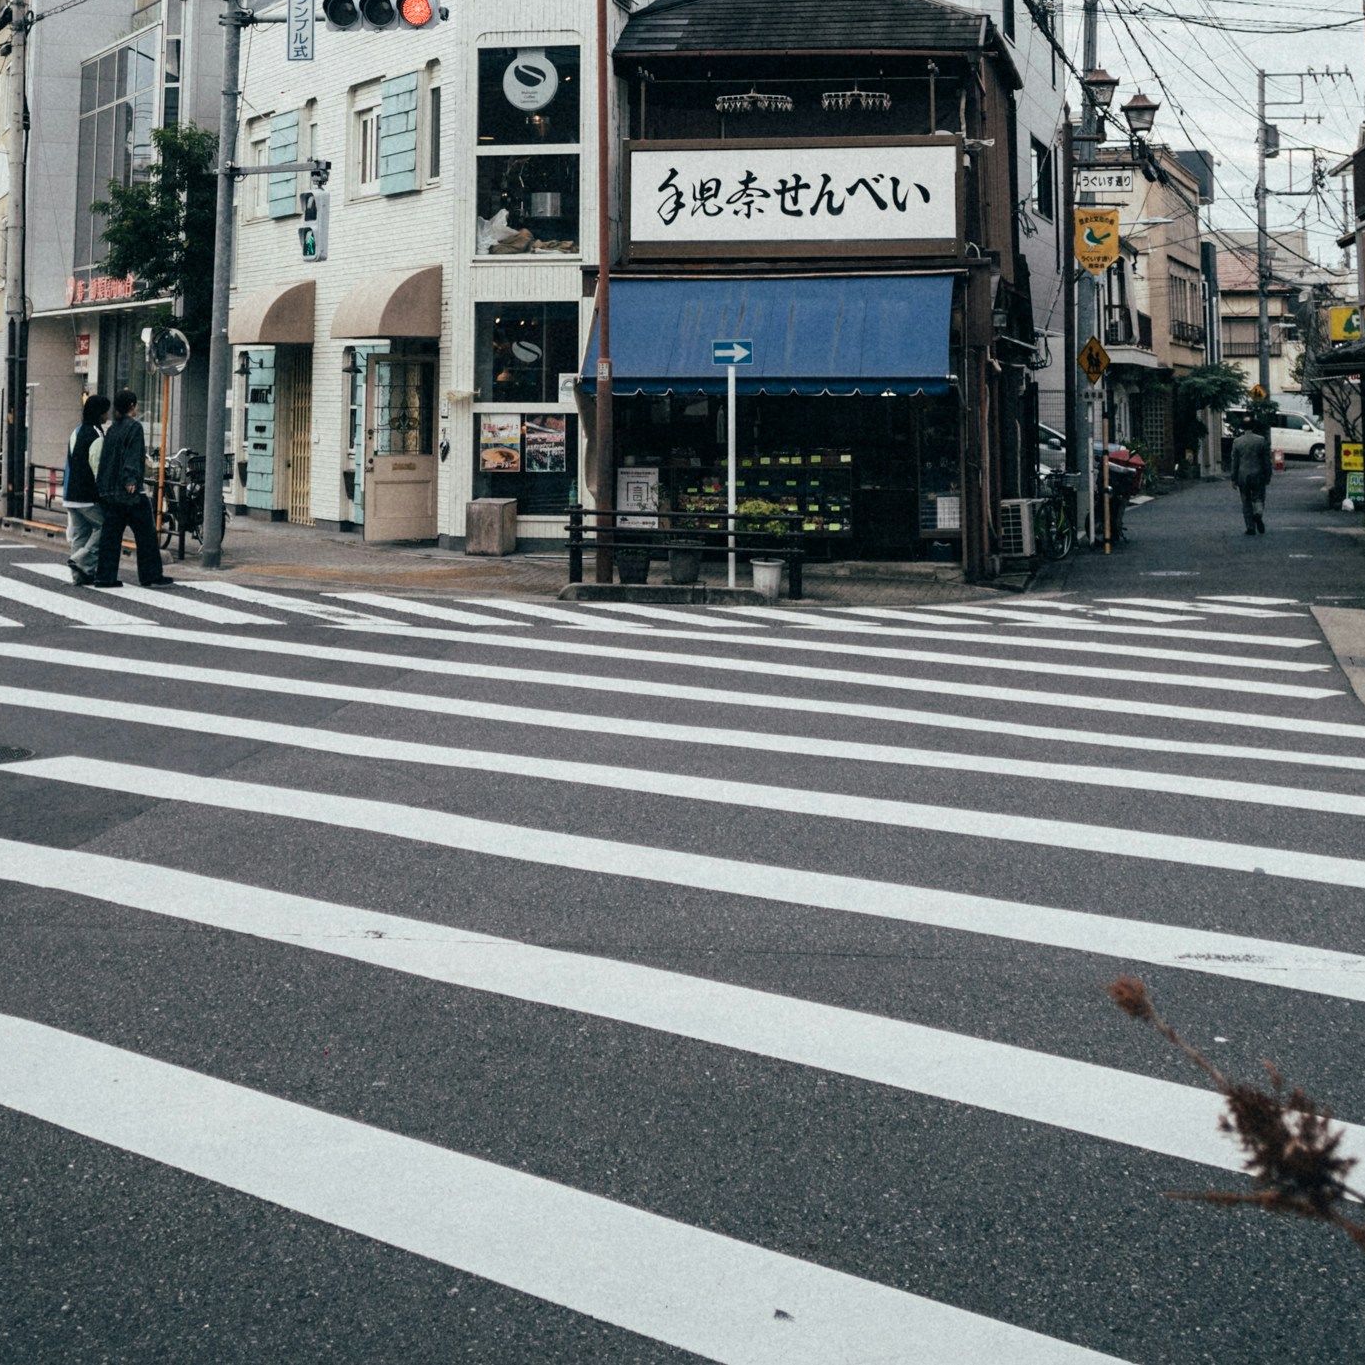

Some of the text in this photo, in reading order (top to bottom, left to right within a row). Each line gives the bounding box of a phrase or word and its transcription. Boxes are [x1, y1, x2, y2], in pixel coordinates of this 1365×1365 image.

[657, 168, 931, 226] 手児奈せんべい
[1082, 176, 1131, 187] うぐいす通り
